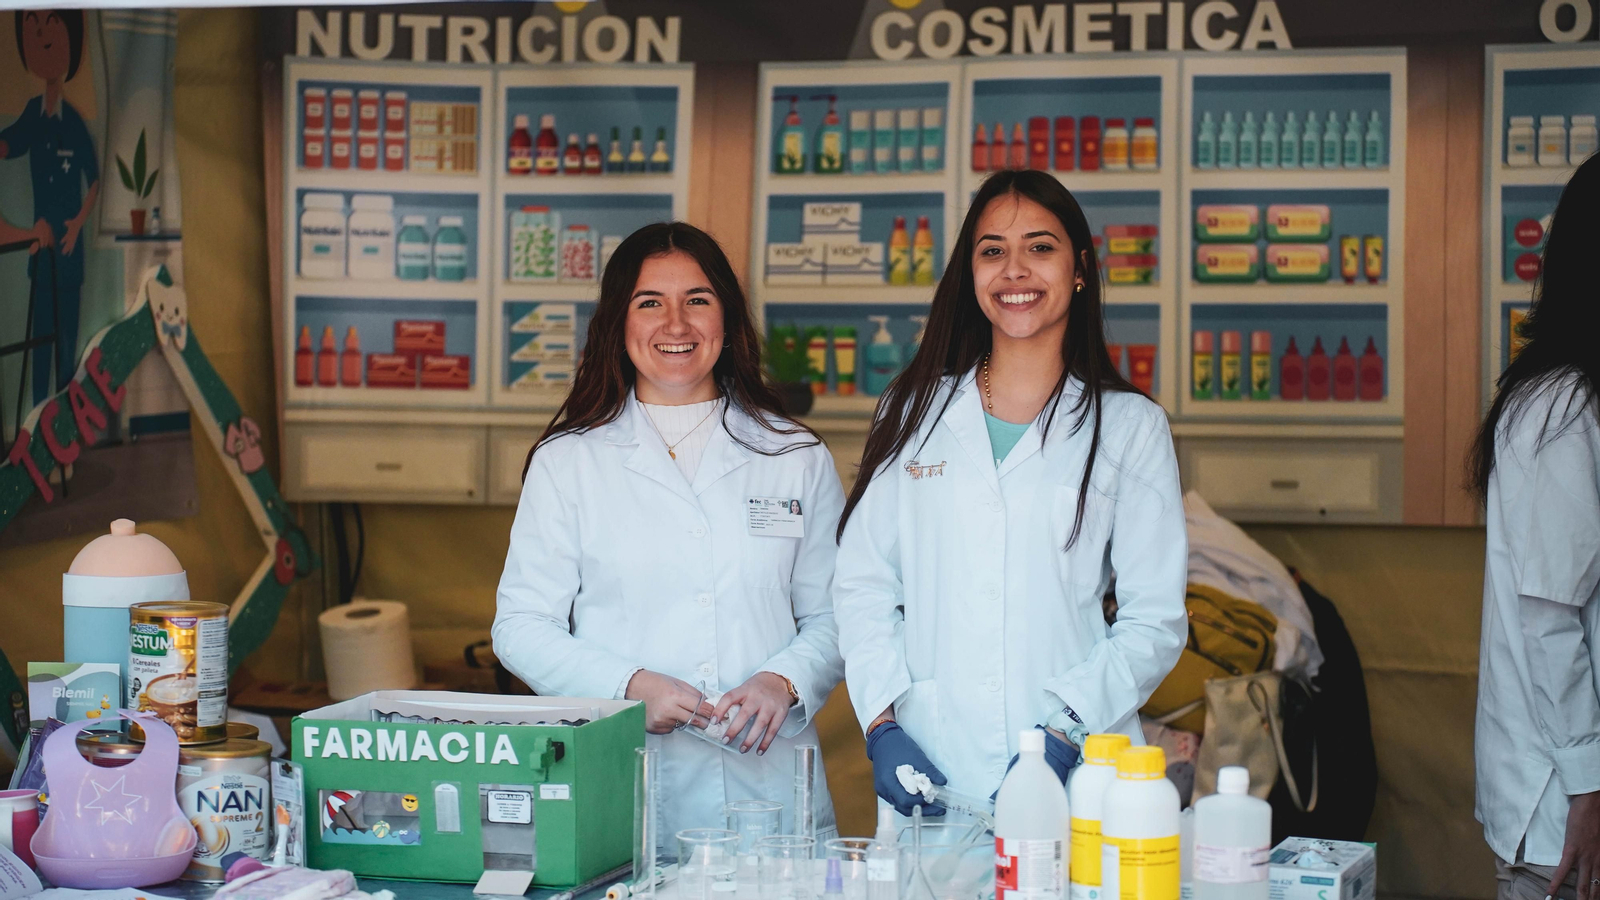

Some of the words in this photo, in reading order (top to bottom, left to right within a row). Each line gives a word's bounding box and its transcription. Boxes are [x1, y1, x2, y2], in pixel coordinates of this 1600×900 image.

[297, 10, 681, 64] NUTRICION
[870, 0, 1293, 60] COSMETICA
[9, 347, 127, 503] TCAE
[130, 633, 175, 650] ESTUM
[52, 686, 95, 699] Blemil
[303, 726, 519, 765] FARMACIA
[197, 788, 262, 813] NAN
[210, 814, 253, 822] SUPREME
[255, 811, 264, 832] 2
